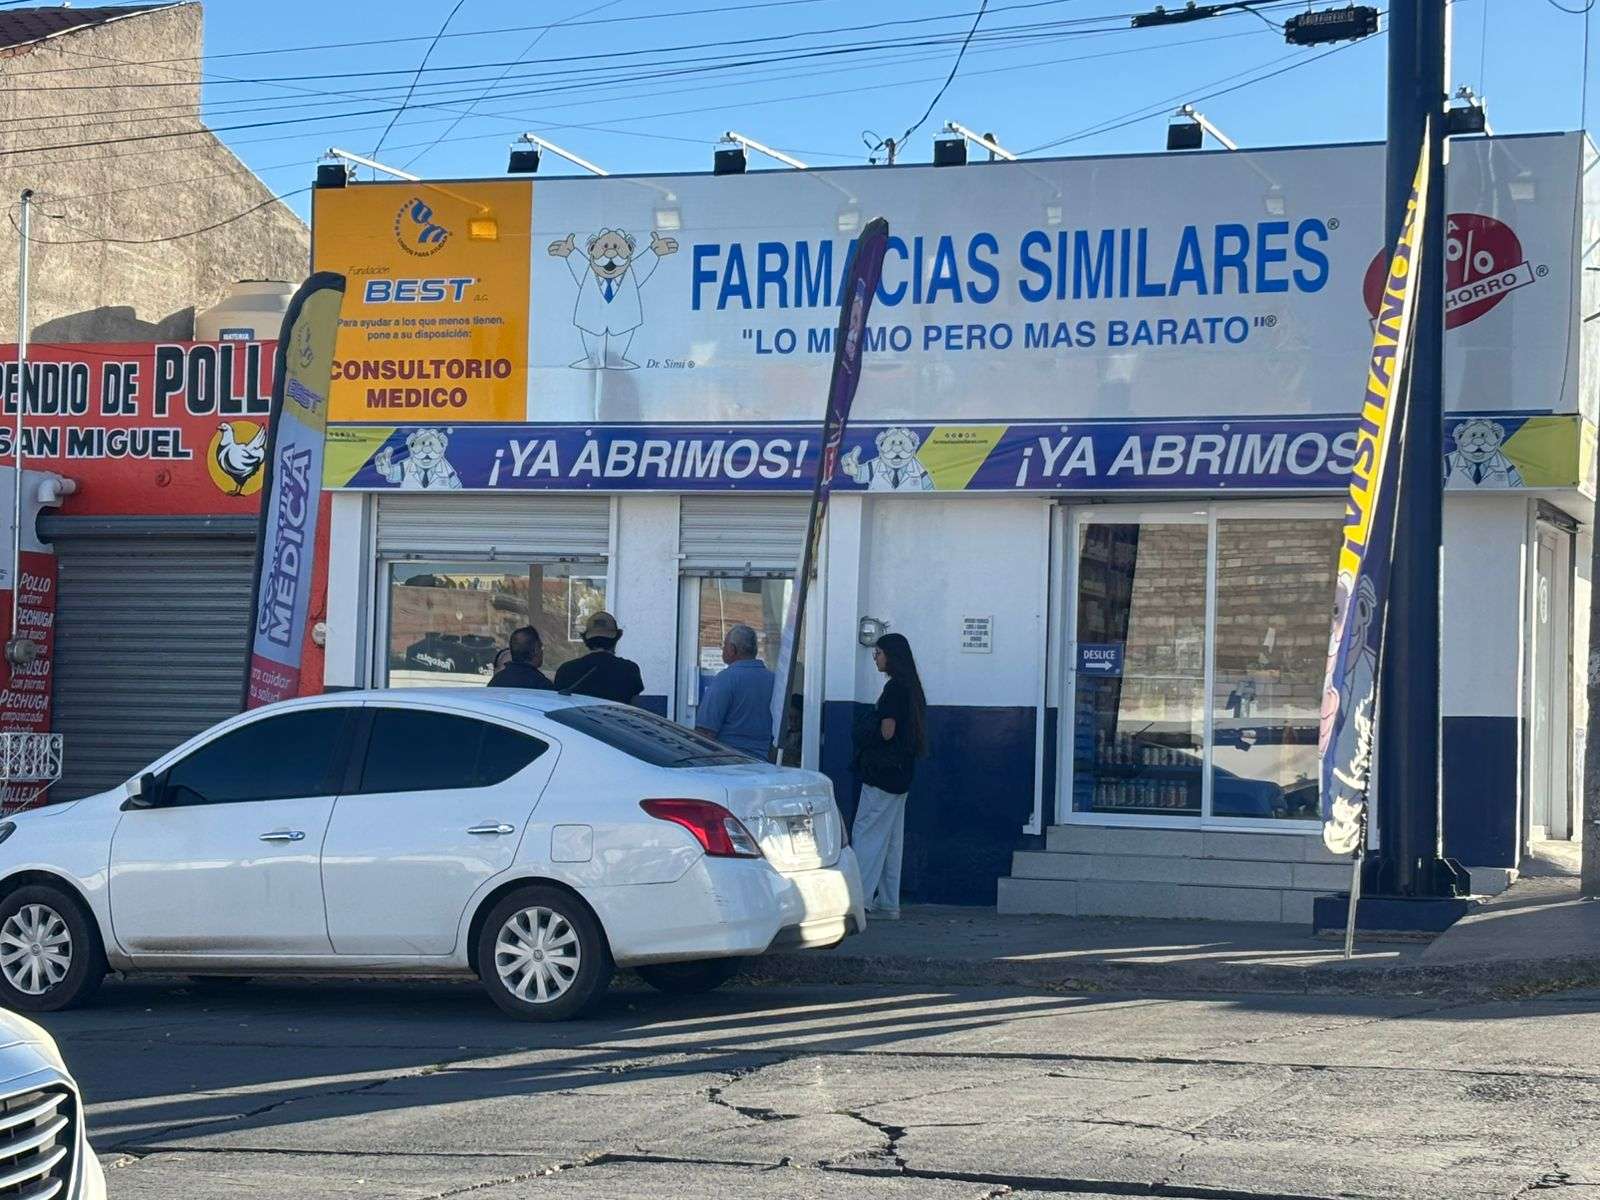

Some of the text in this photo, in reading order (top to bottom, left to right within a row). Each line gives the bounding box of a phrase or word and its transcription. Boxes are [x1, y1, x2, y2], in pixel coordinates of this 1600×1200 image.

[1018, 218, 1329, 302] SIMILARES
[364, 277, 475, 304] BEST
[1445, 272, 1519, 309] HORRO
[360, 318, 392, 329] ayudar
[393, 319, 400, 327] a
[402, 317, 416, 327] los
[418, 318, 436, 328] que
[438, 317, 471, 326] menos
[367, 332, 391, 341] pone
[392, 331, 400, 339] a
[401, 331, 413, 339] su
[807, 325, 912, 354] MIMO
[923, 323, 1013, 351] PERO
[1024, 320, 1096, 349] MAS
[0, 343, 281, 418] ENDIO DE POLL
[330, 358, 512, 381] CONSULTORIO
[366, 386, 468, 408] MEDICO
[0, 426, 193, 460] SAN MIGUEL
[569, 438, 808, 479] ABRIMOS!
[268, 448, 313, 649] MEDICA
[18, 572, 52, 593] POLLO
[1083, 650, 1115, 660] DESLICE
[0, 689, 49, 710] PECHUGA
